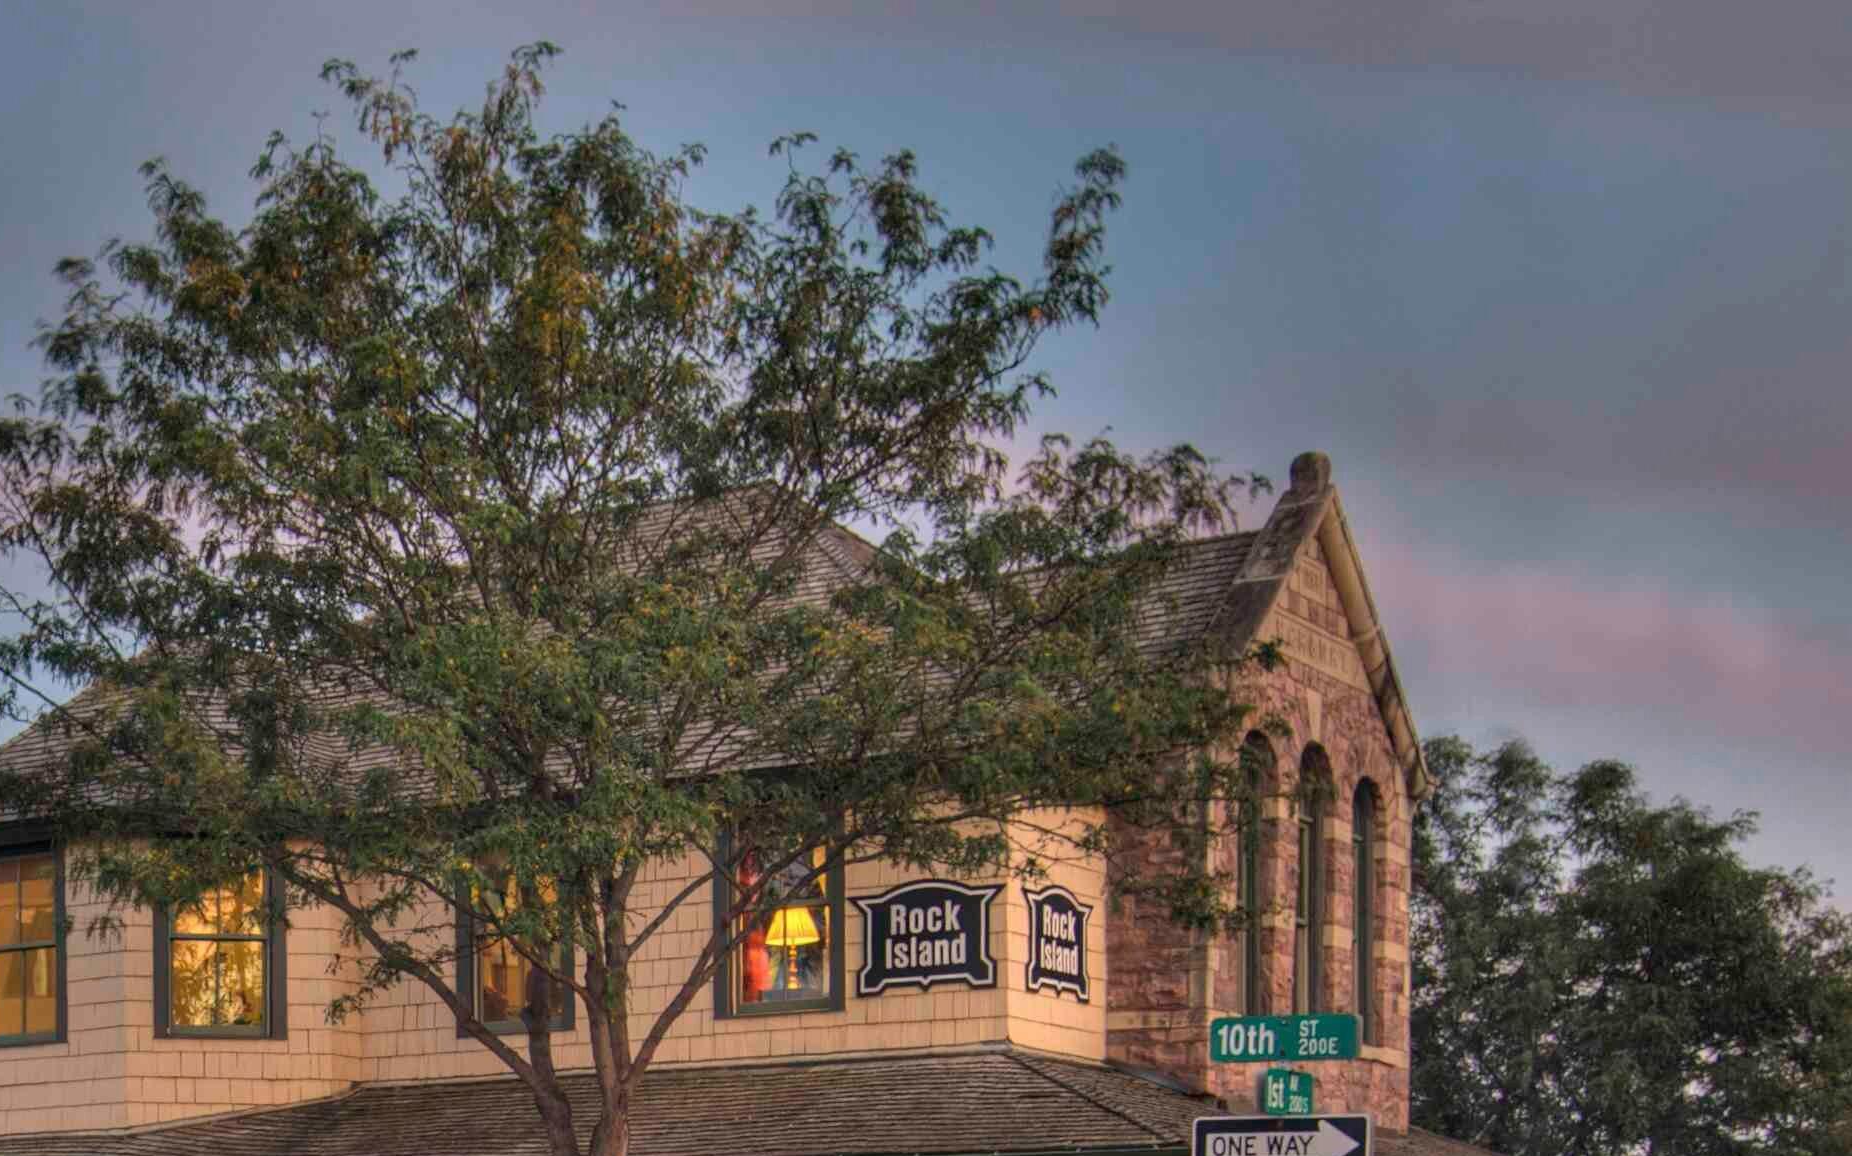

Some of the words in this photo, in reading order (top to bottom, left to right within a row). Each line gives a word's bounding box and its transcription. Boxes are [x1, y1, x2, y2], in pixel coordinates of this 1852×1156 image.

[889, 899, 963, 936] Rock
[1041, 904, 1077, 942] Rock
[885, 932, 967, 970] Island
[1040, 937, 1079, 976] Island
[1217, 1022, 1276, 1056] 10th
[1299, 1019, 1320, 1037] ST
[1298, 1037, 1340, 1056] 200E
[1212, 1135, 1257, 1156] ONE
[1267, 1135, 1314, 1156] WAY
